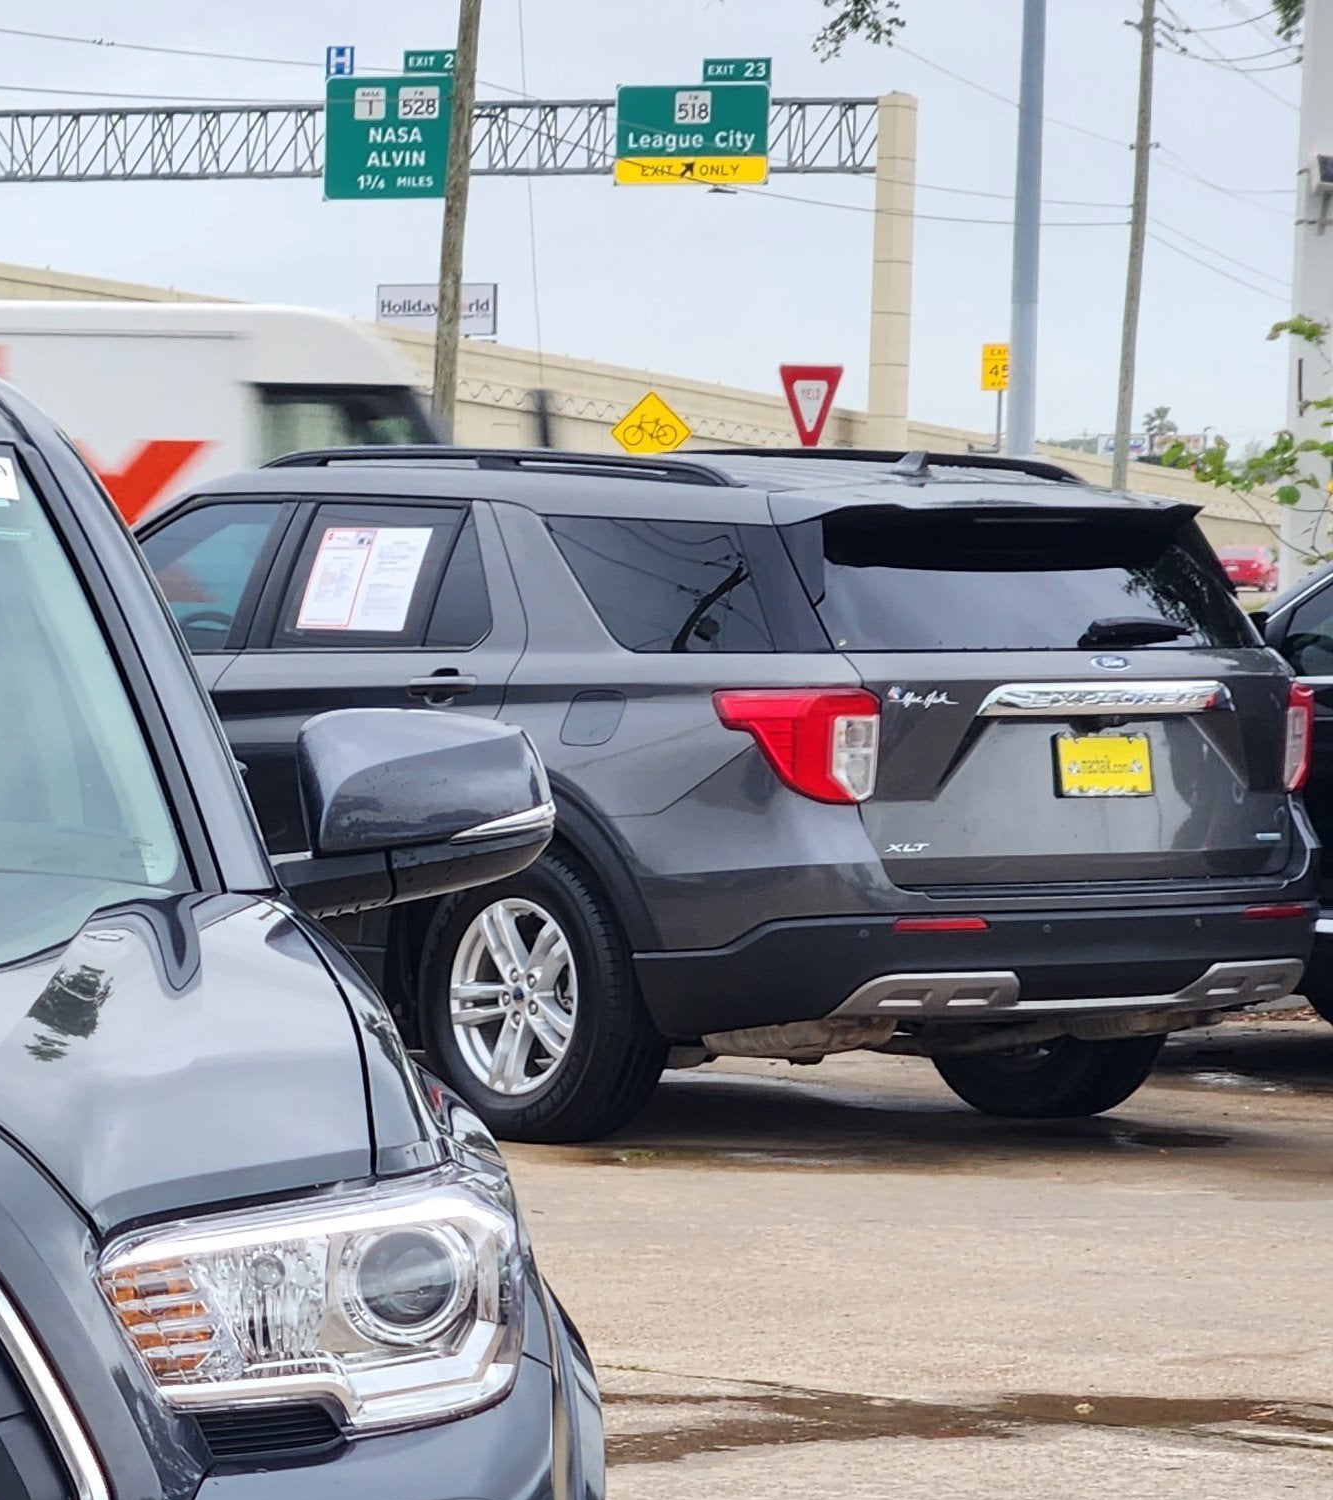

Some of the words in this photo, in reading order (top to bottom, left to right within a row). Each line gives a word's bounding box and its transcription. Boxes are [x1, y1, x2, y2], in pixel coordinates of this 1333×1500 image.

[408, 56, 435, 67] EXIT
[444, 53, 455, 69] 2
[707, 64, 735, 76] EXIT
[743, 62, 767, 78] 23
[401, 99, 437, 116] 528
[677, 103, 709, 121] 518
[368, 126, 424, 144] NASA
[628, 131, 704, 152] League
[714, 130, 756, 152] City
[366, 150, 426, 168] ALVIN
[640, 165, 674, 177] EXIT
[699, 164, 740, 177] ONLY
[396, 175, 434, 188] MILES
[884, 843, 930, 853] XLT
